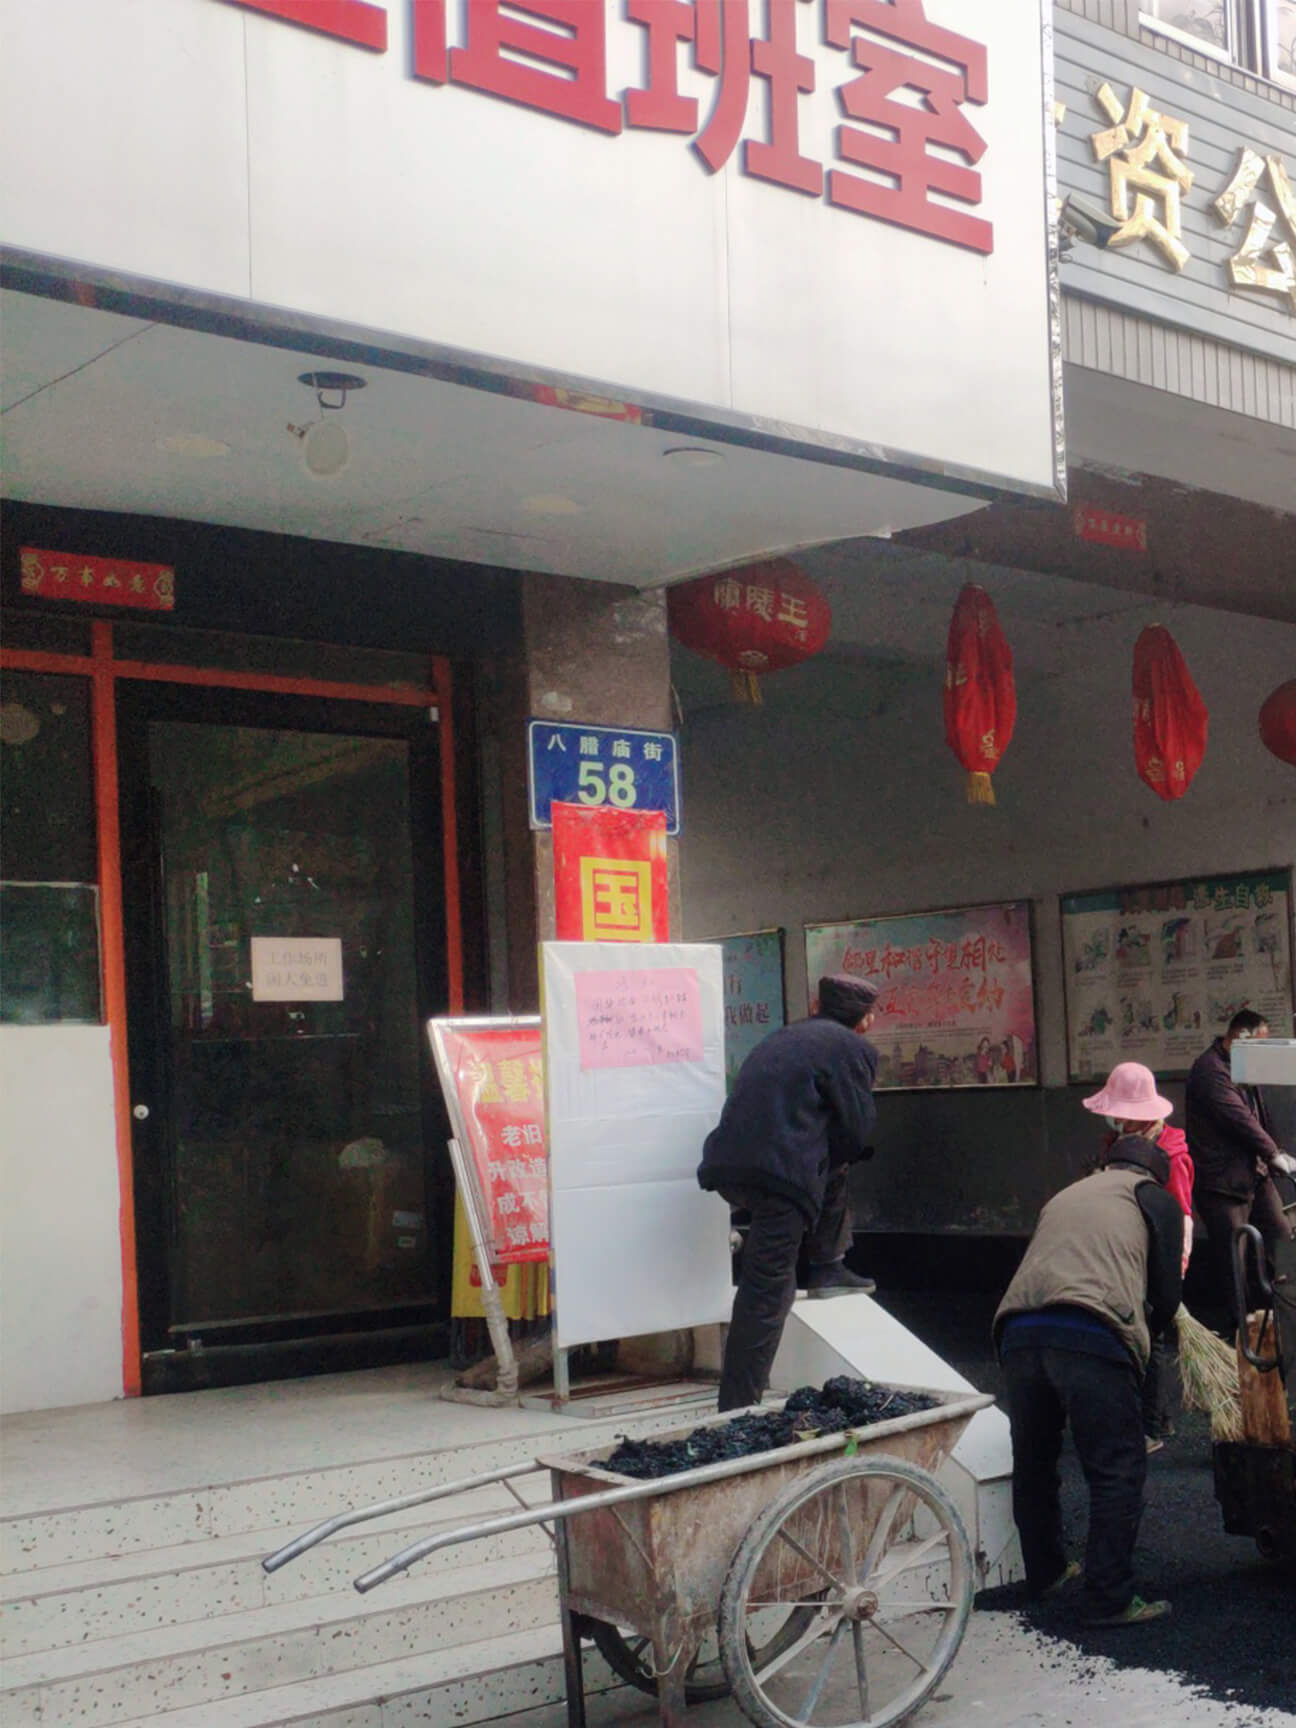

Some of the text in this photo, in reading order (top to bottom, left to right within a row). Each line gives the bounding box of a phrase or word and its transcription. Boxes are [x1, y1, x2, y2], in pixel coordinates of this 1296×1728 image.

[547, 733, 663, 762] 八腊庙街
[577, 760, 638, 809] 58
[501, 1123, 543, 1148] 老旧
[497, 1191, 548, 1215] 成不
